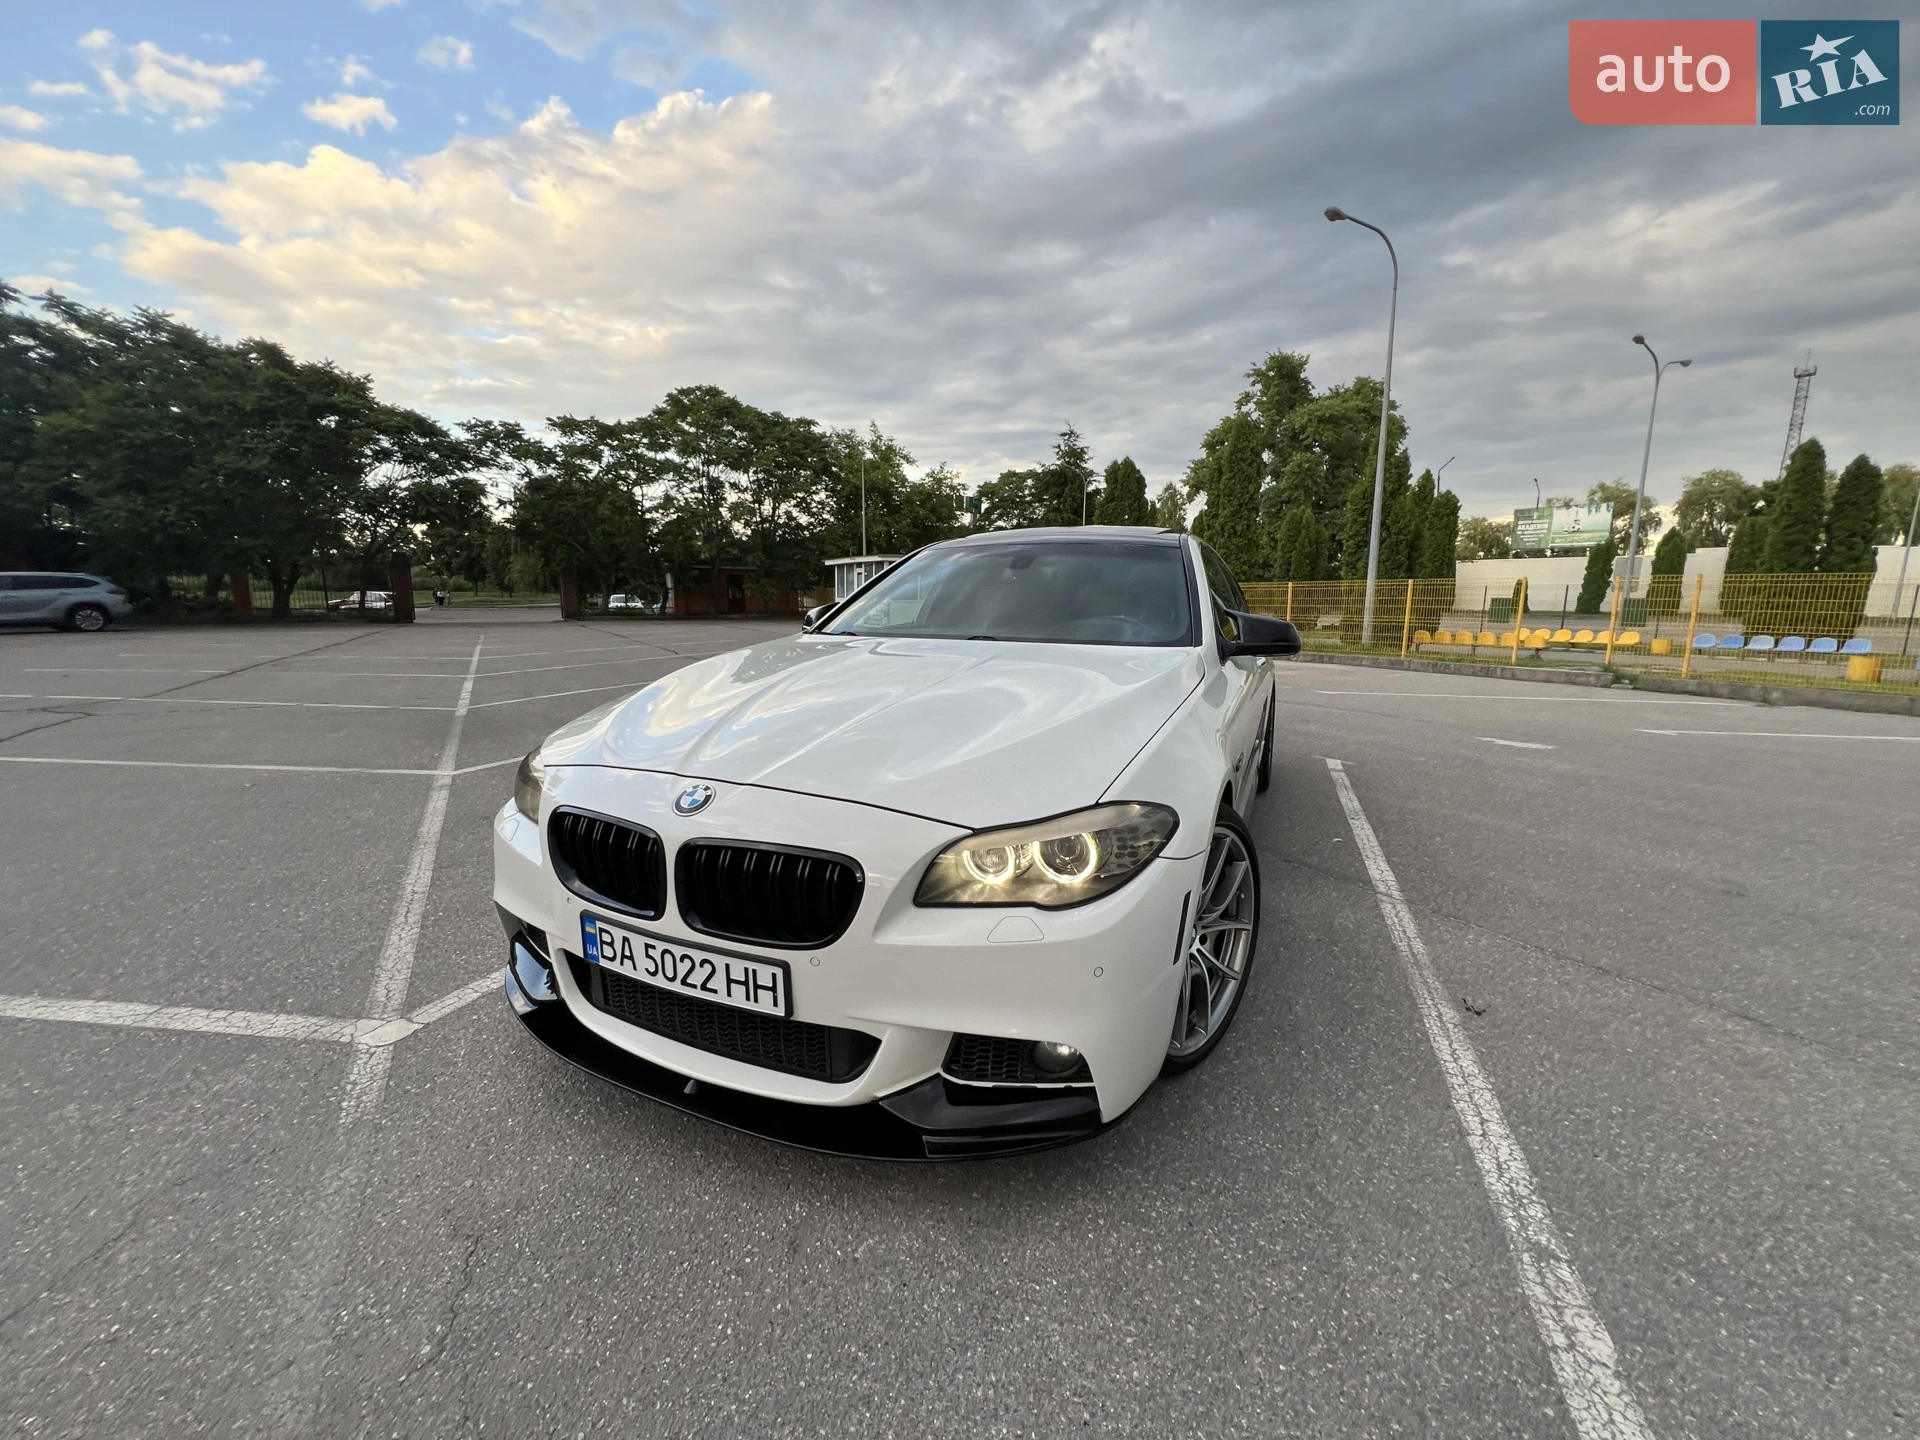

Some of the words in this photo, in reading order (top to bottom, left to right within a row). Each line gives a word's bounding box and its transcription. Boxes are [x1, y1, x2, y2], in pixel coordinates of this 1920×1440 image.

[587, 944, 599, 957] UA
[598, 926, 638, 972] BA
[644, 942, 719, 995] 5022
[725, 962, 779, 1008] HH
